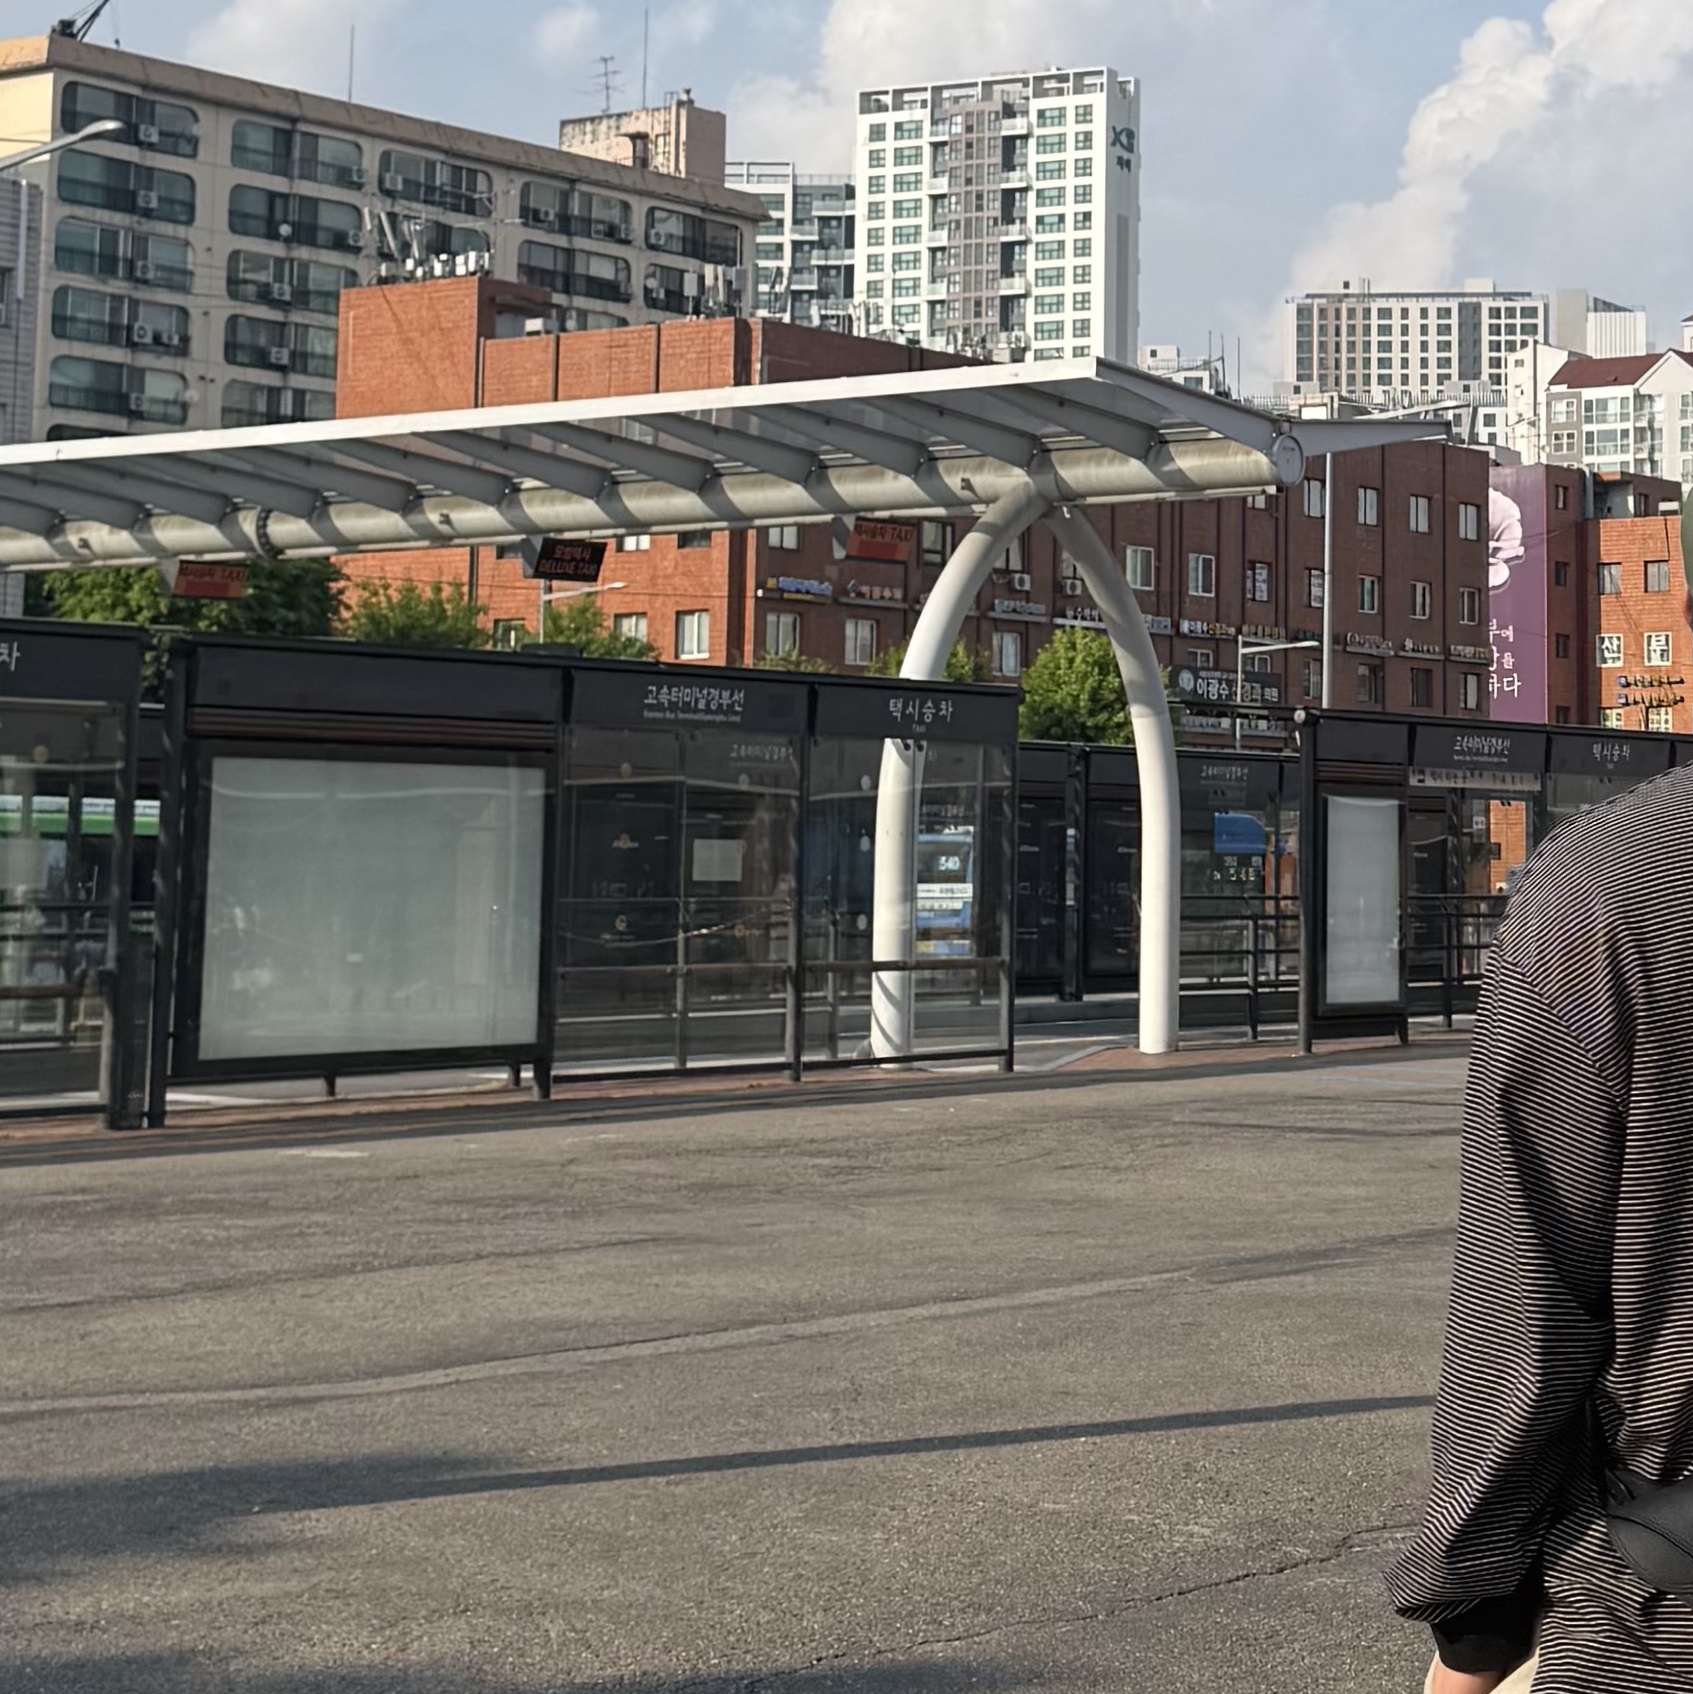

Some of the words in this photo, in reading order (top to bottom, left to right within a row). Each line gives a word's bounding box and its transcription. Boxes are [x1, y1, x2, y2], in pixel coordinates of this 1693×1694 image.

[644, 685, 745, 711] 고속터미널경부선
[1197, 678, 1229, 700] 이광수
[889, 698, 954, 723] 택시승차
